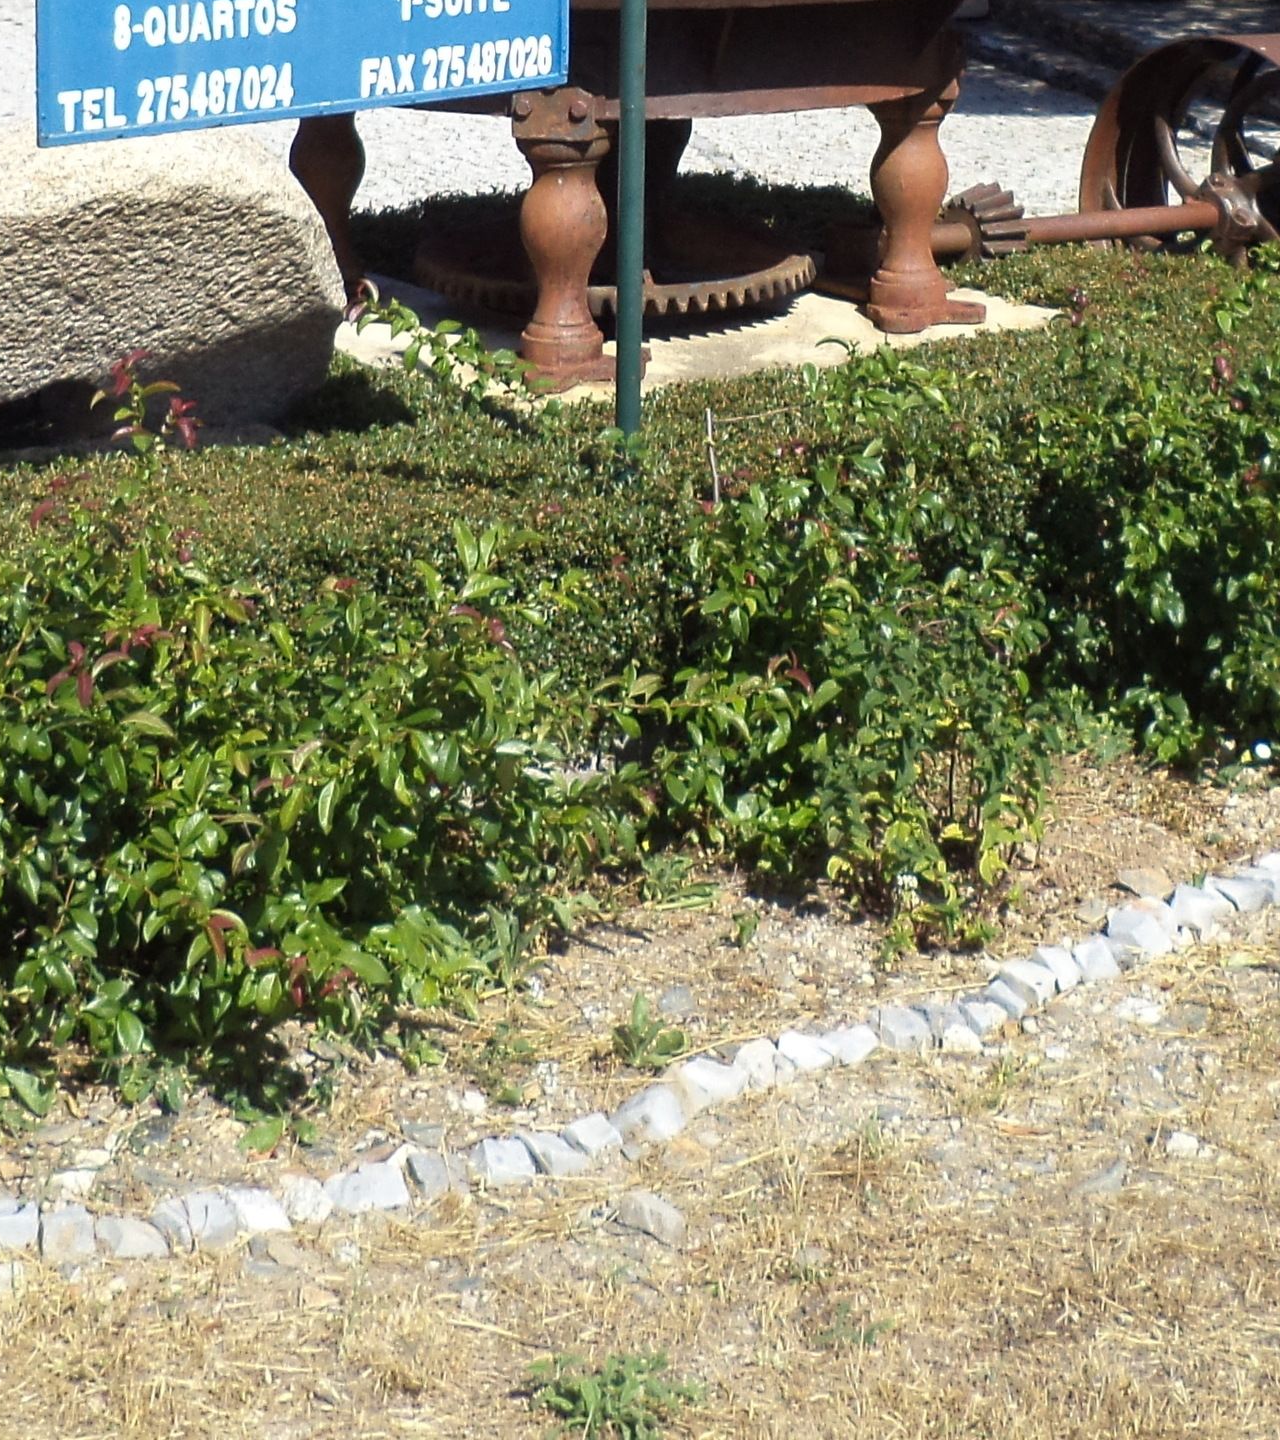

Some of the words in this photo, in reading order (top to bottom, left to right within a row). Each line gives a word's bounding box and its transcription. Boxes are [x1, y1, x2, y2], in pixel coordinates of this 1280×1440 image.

[58, 87, 127, 133] TEL
[137, 63, 295, 126] 275487024
[360, 52, 415, 99] FAX
[421, 34, 552, 94] 275487026
